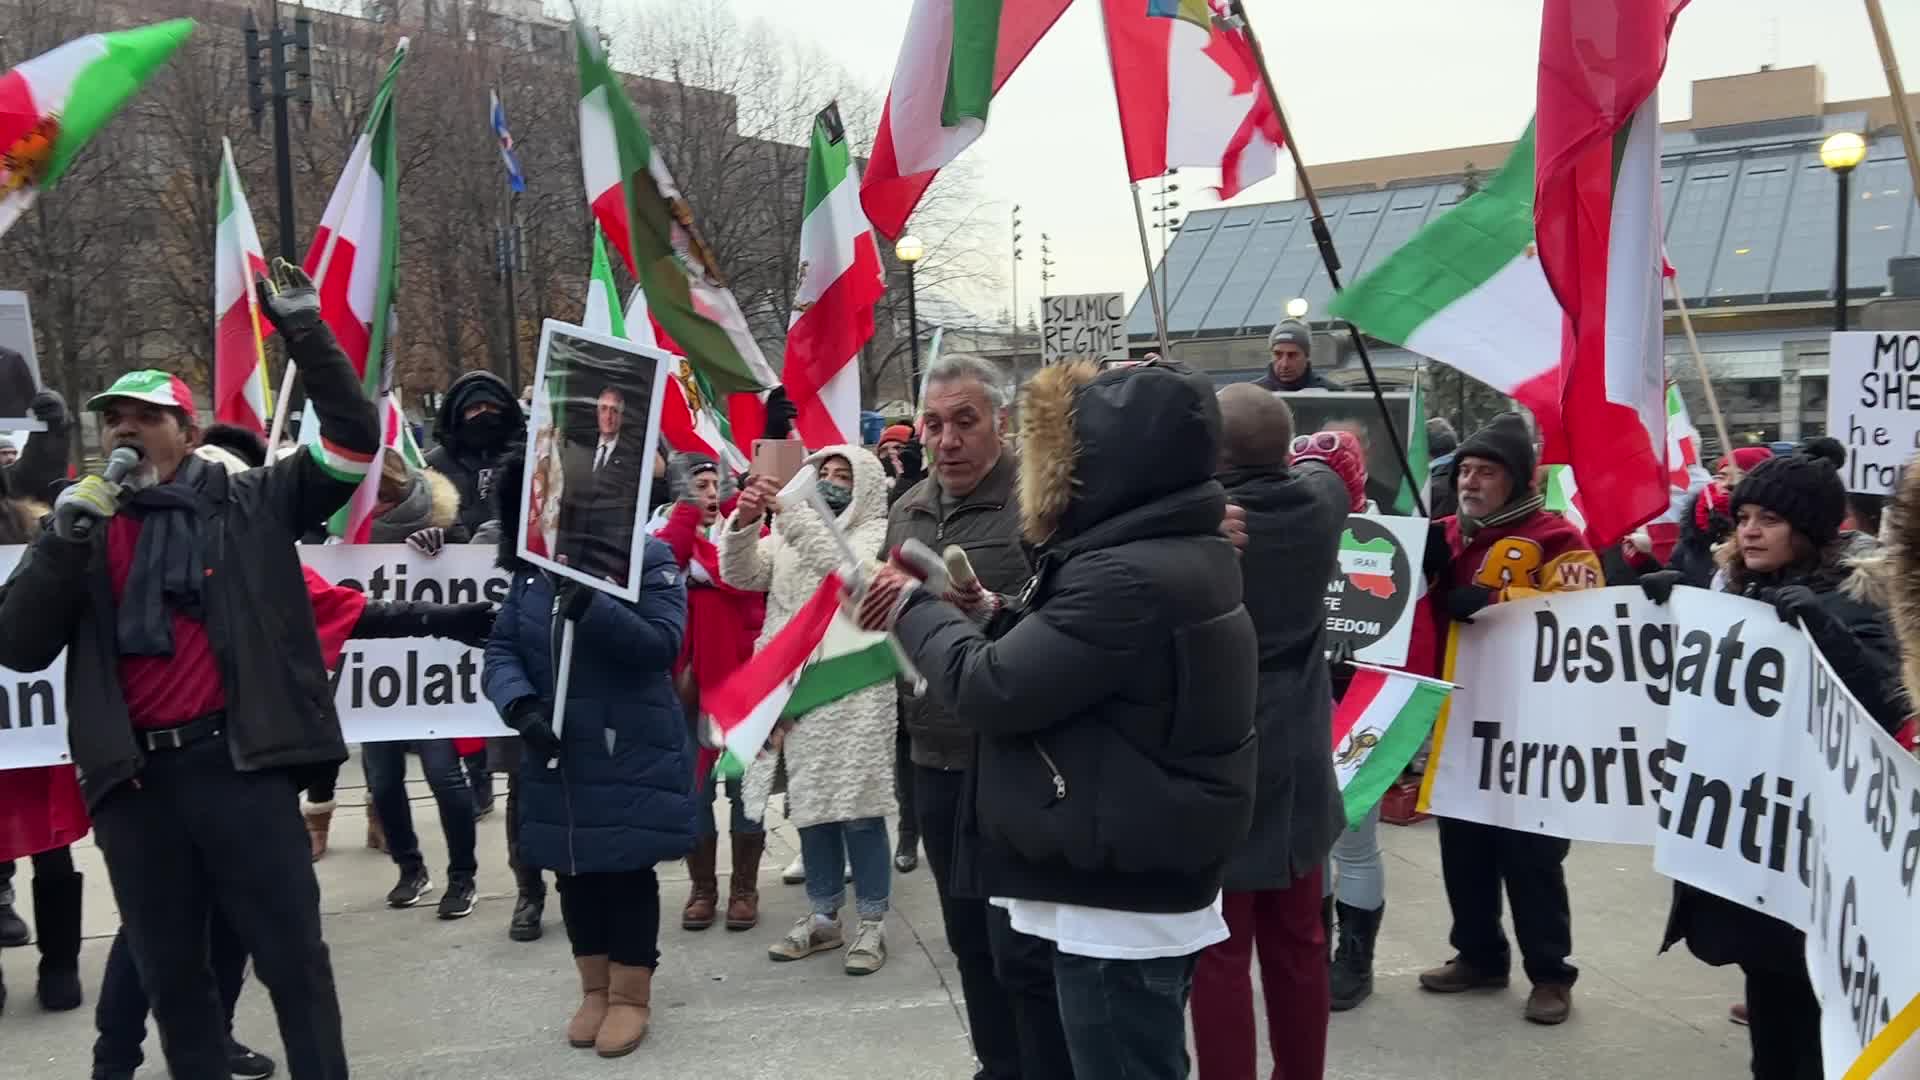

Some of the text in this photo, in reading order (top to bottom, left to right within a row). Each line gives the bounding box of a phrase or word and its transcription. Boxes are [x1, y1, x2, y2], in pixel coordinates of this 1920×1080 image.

[1042, 295, 1121, 324] ISLAMIC
[1044, 324, 1123, 354] REGIME
[1850, 448, 1904, 490] Ira
[1354, 557, 1379, 568] IRAN
[1865, 738, 1900, 852] as
